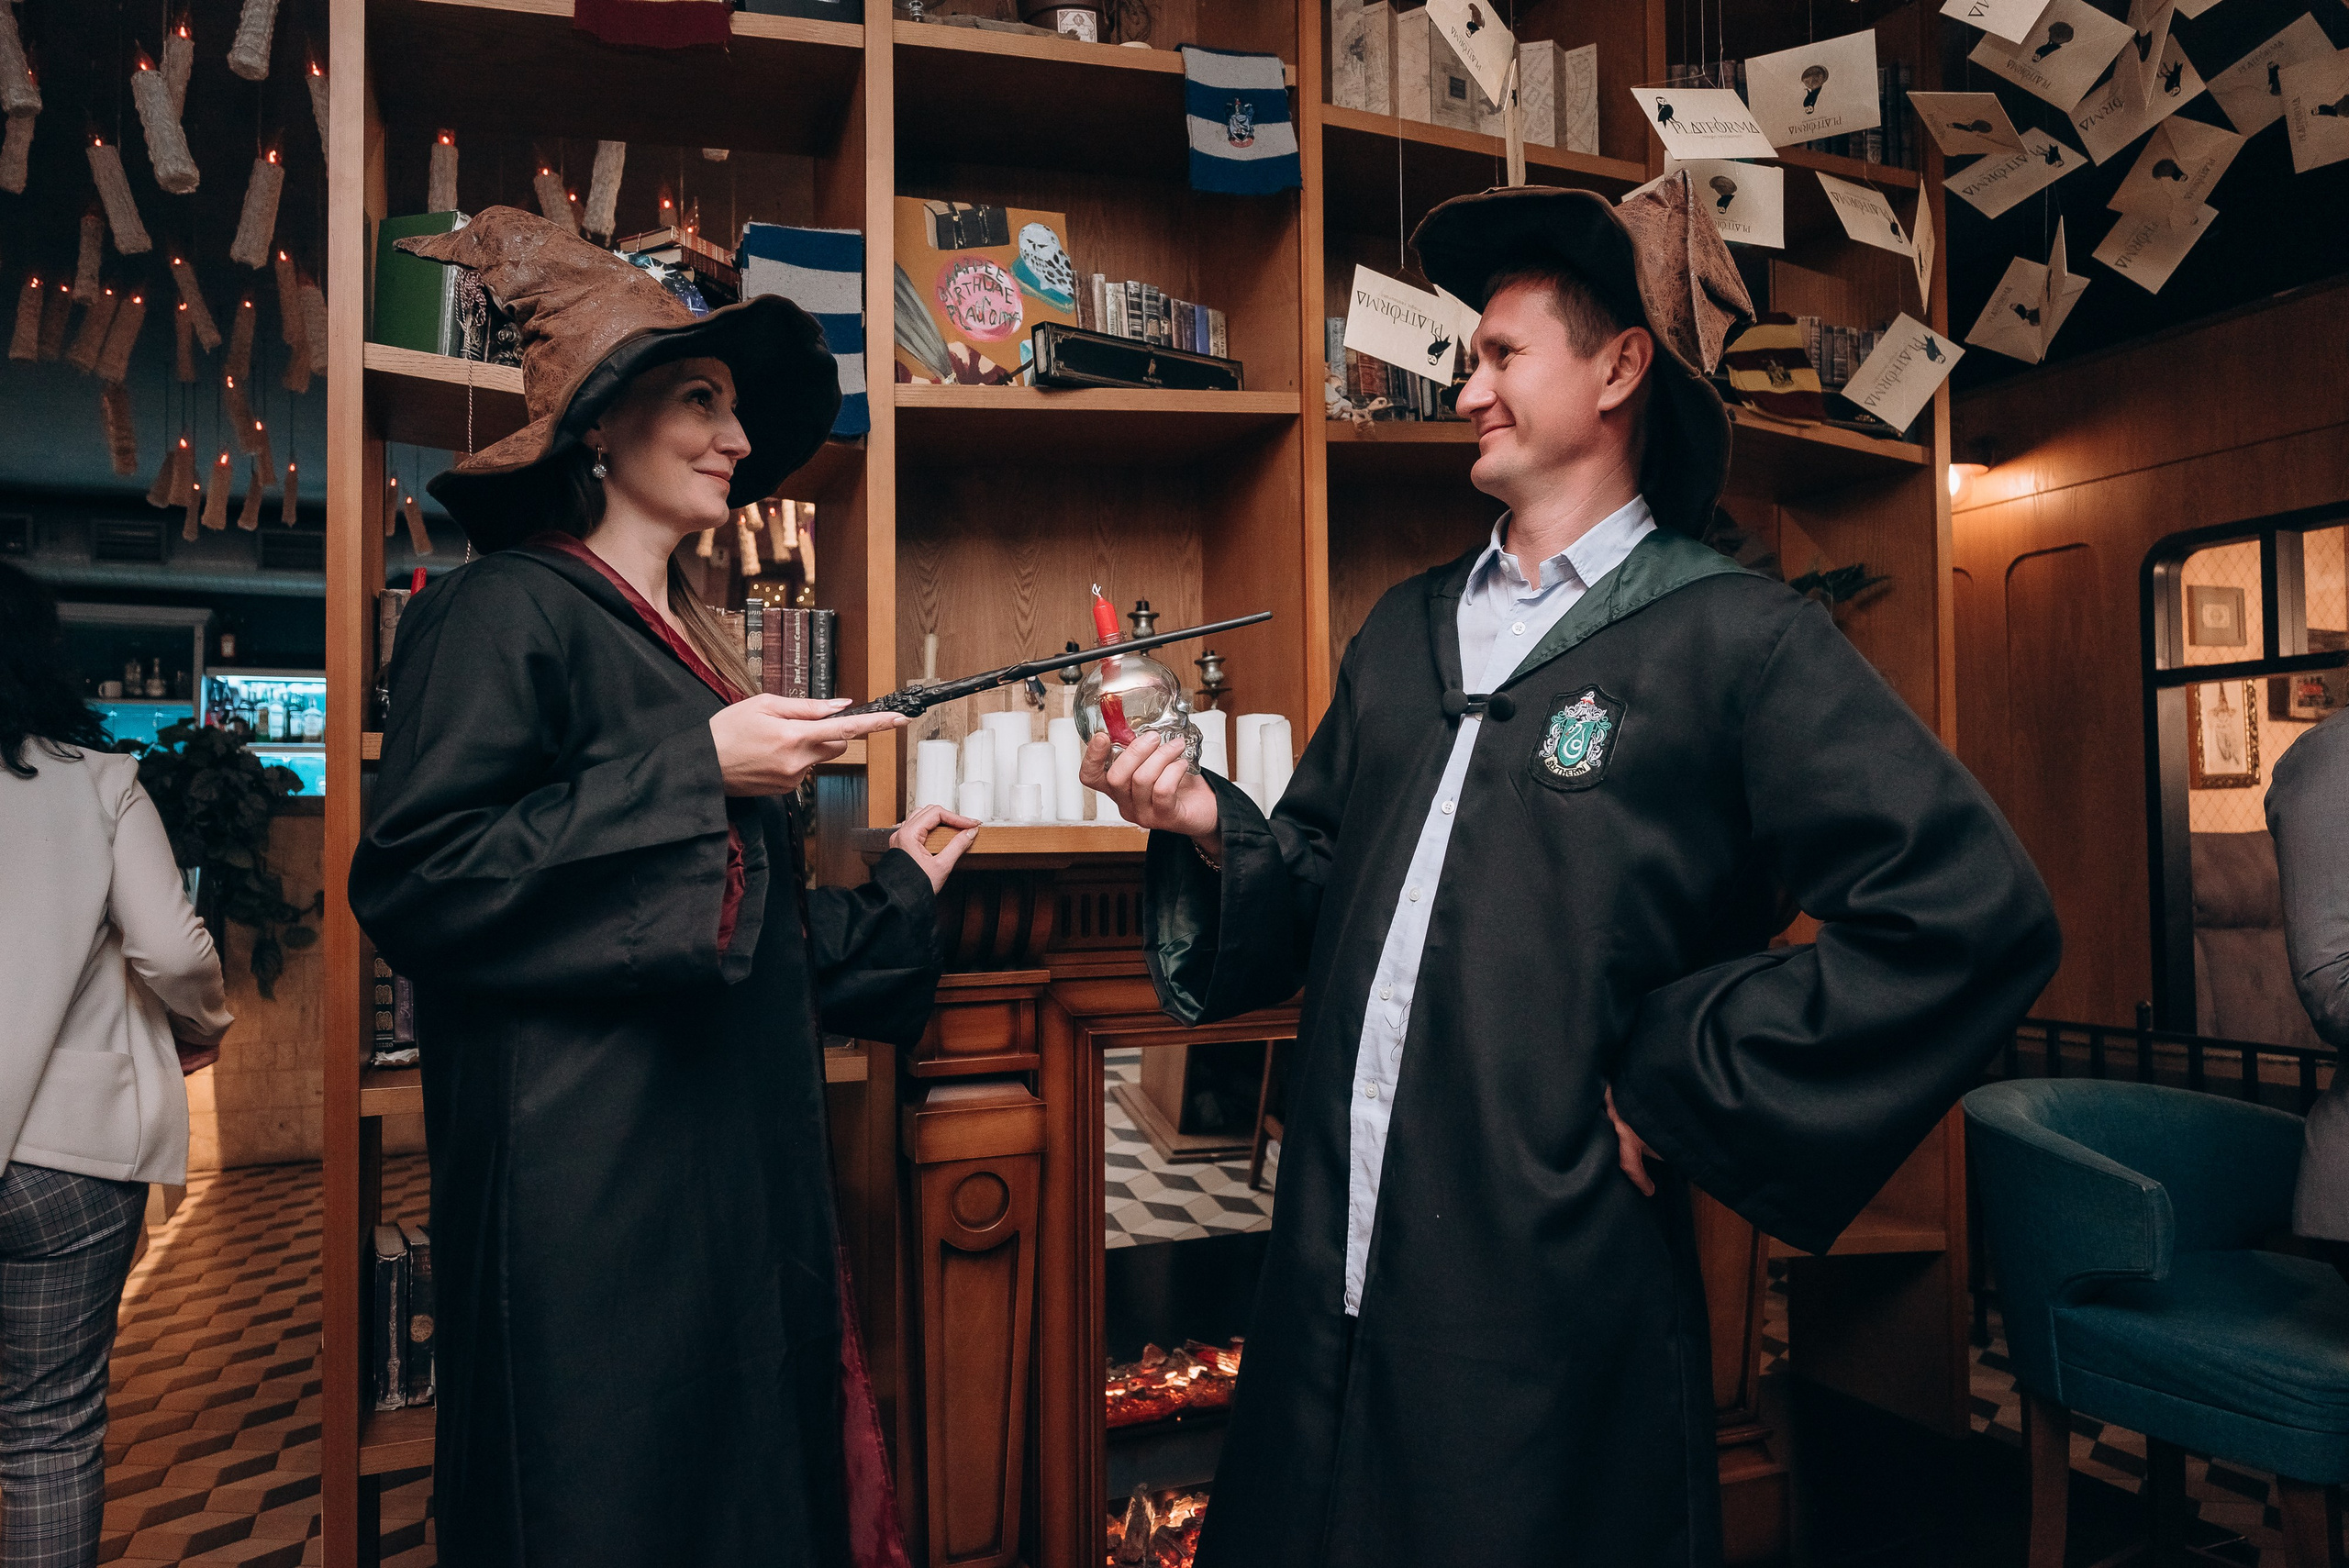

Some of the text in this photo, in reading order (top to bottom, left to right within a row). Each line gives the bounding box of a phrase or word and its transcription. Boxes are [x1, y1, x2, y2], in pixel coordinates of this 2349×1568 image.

[1671, 117, 1761, 134] PLATFORMA
[1357, 290, 1444, 339] PLATFORMA
[1864, 337, 1926, 407] PLATFORMA
[1545, 759, 1588, 777] SLYTHERIN
